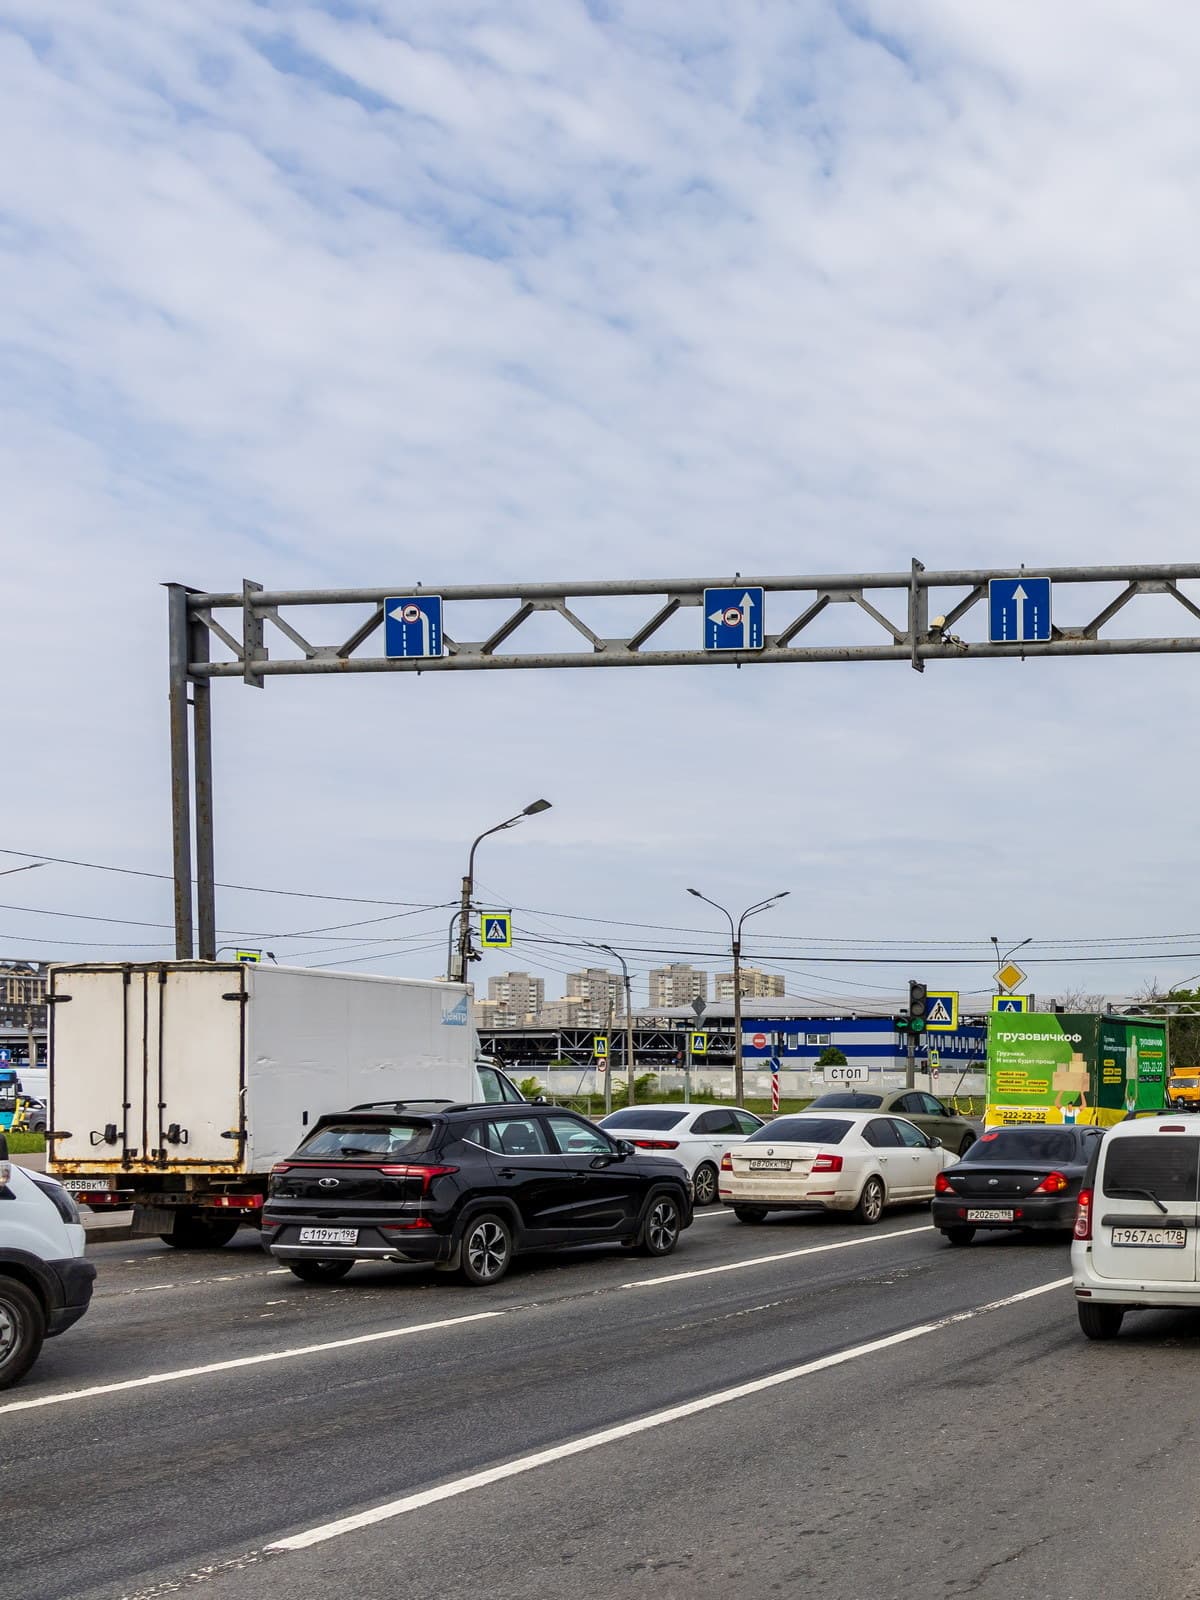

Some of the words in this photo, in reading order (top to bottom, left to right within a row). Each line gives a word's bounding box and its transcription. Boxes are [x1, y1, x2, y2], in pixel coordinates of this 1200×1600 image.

[996, 1032, 1082, 1043] грузовичкоф
[831, 1069, 861, 1079] СТОП
[1003, 1111, 1046, 1120] 222-22-22
[341, 1230, 355, 1238] 198
[1165, 1230, 1182, 1241] 178
